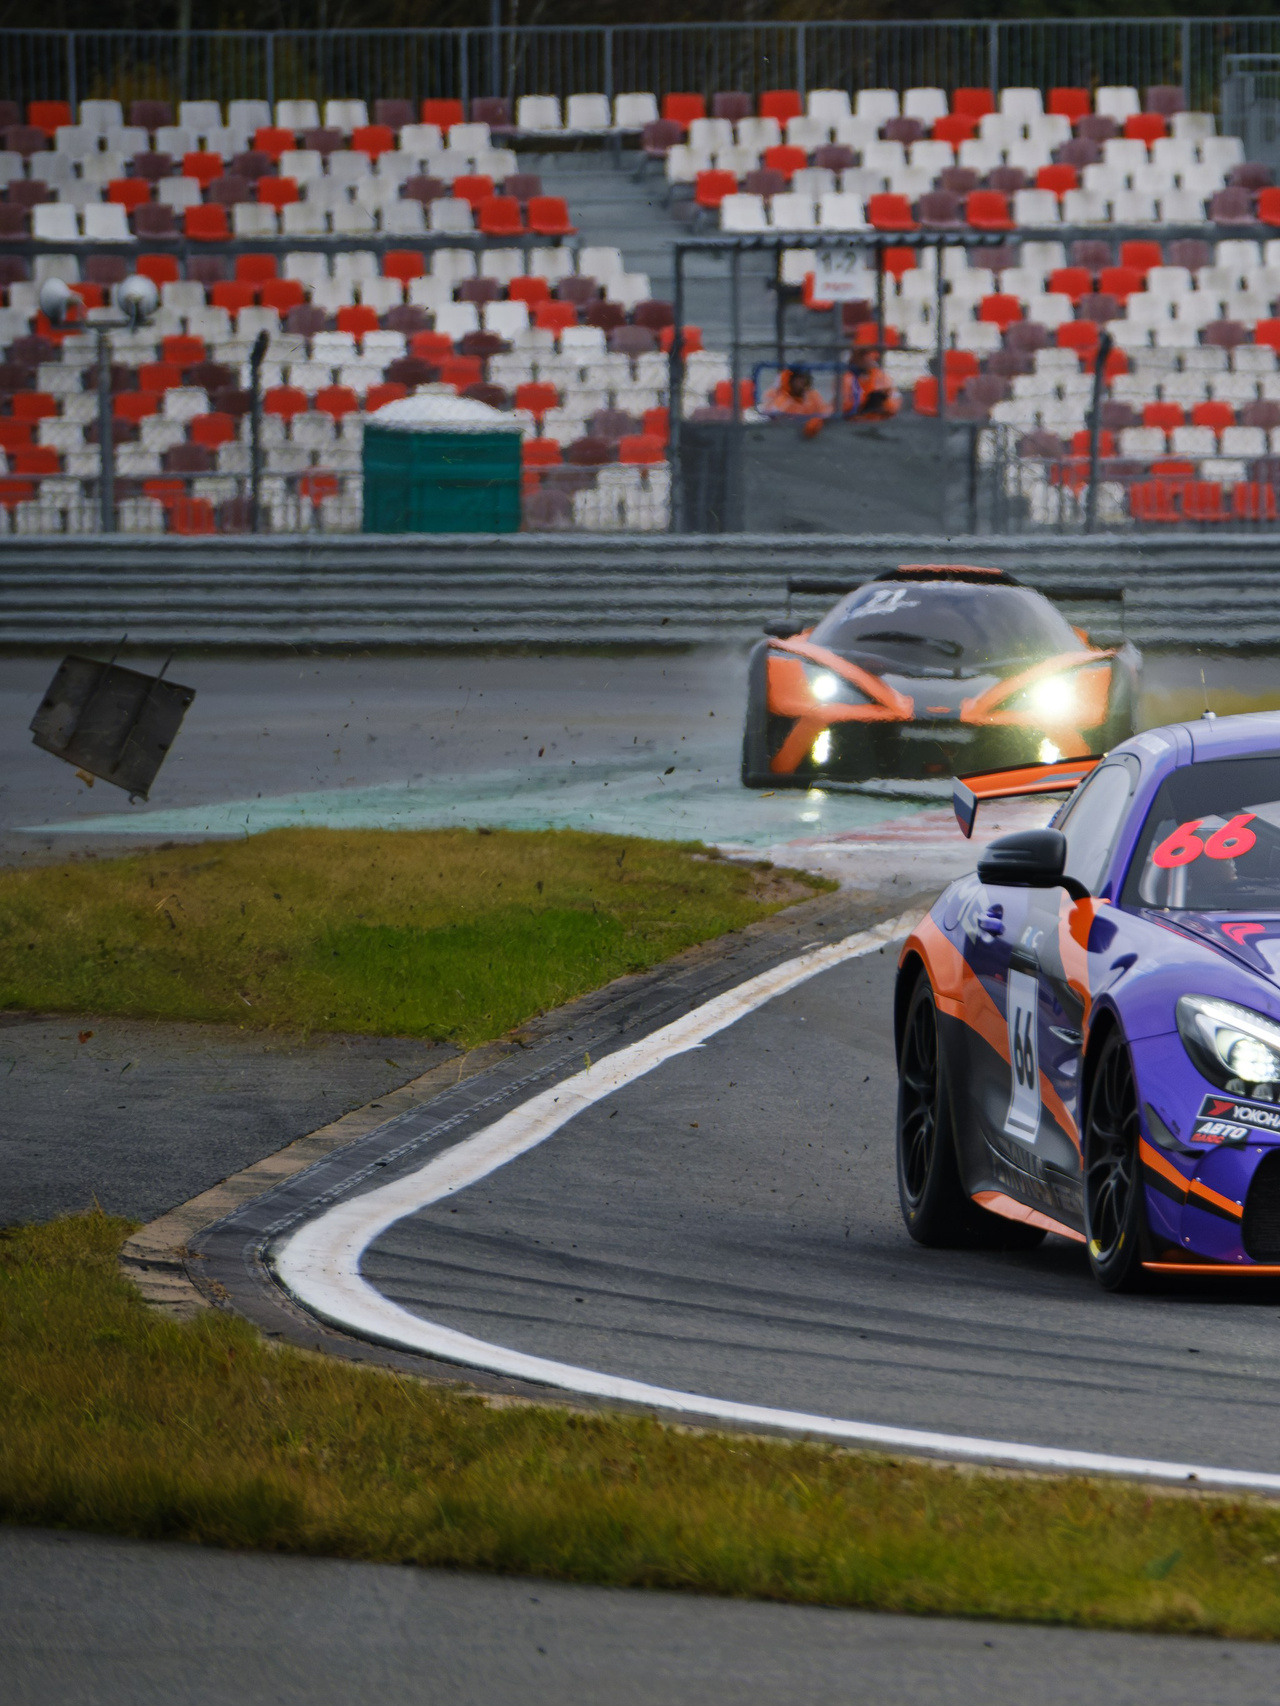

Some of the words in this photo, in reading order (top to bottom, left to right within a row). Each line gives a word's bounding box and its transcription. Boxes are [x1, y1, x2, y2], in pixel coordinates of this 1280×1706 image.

[1152, 813, 1257, 869] 66
[1014, 1006, 1034, 1090] 66
[1196, 1121, 1248, 1140] АВТО
